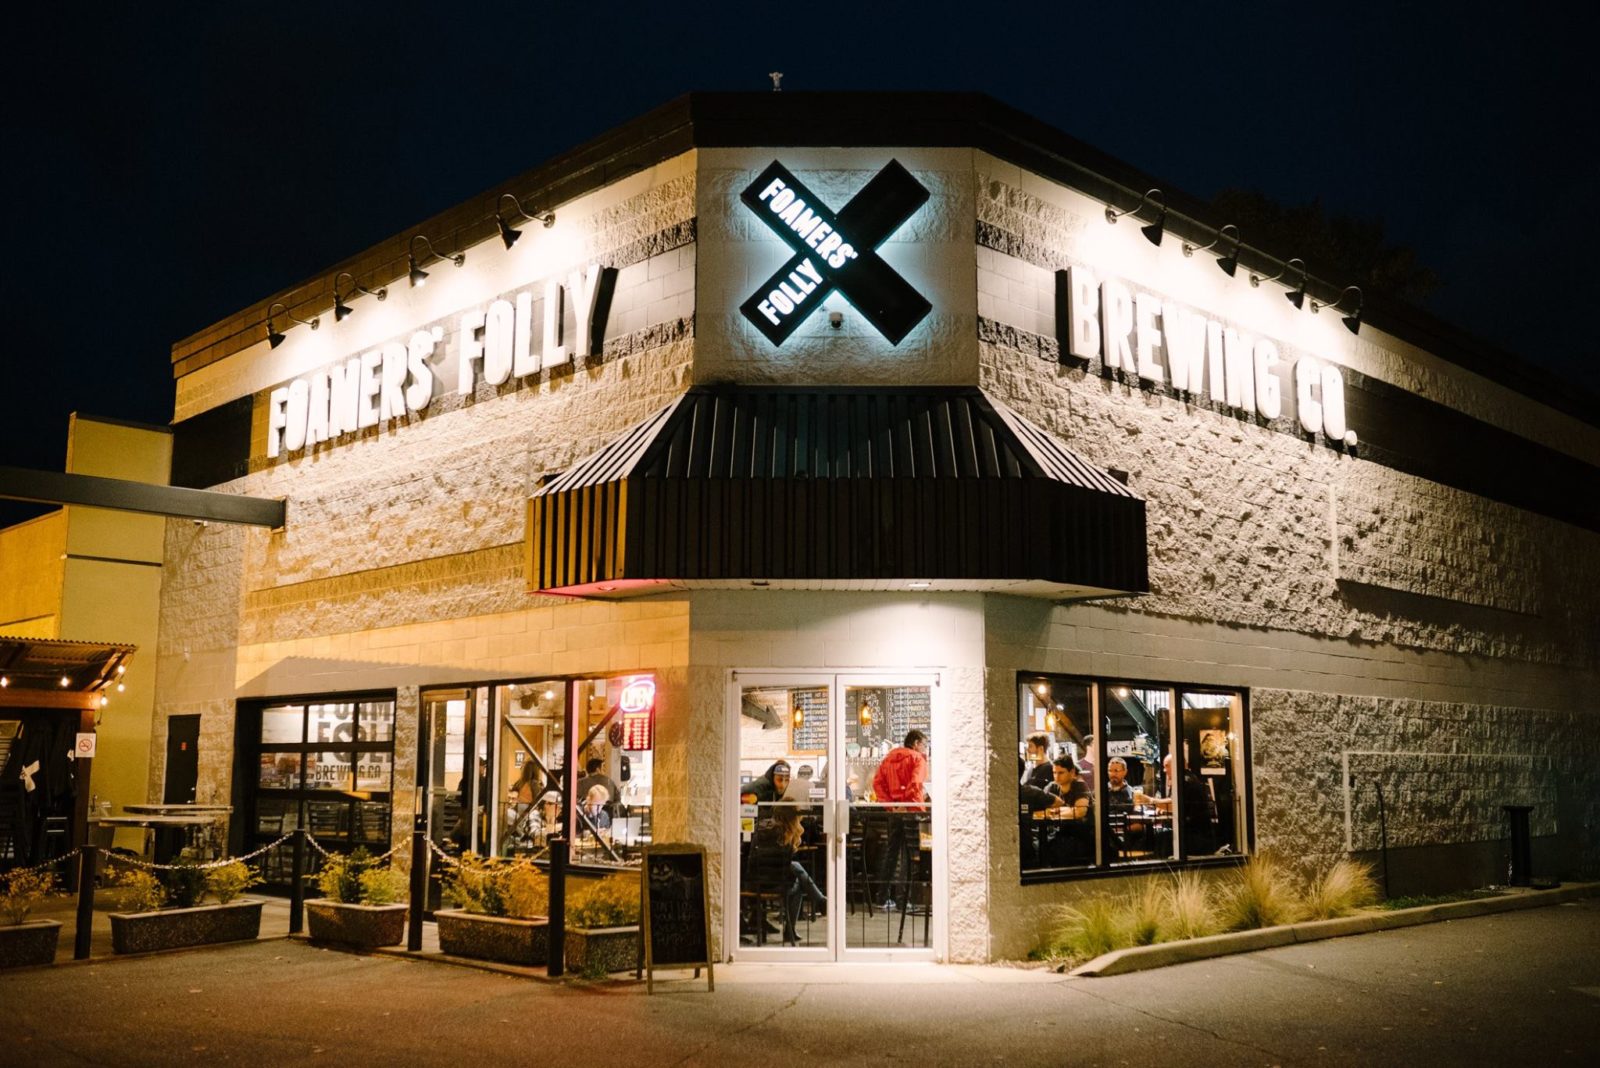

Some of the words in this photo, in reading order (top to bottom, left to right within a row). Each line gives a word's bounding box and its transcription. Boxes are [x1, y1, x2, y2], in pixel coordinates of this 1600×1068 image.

[758, 177, 859, 269] FOAMERS'
[757, 257, 824, 326] FOLLY
[267, 326, 444, 459] FOAMERS'
[457, 264, 605, 395] FOLLY
[1066, 265, 1282, 420] BREWING
[1295, 354, 1359, 447] CO.
[622, 686, 654, 709] OPEN
